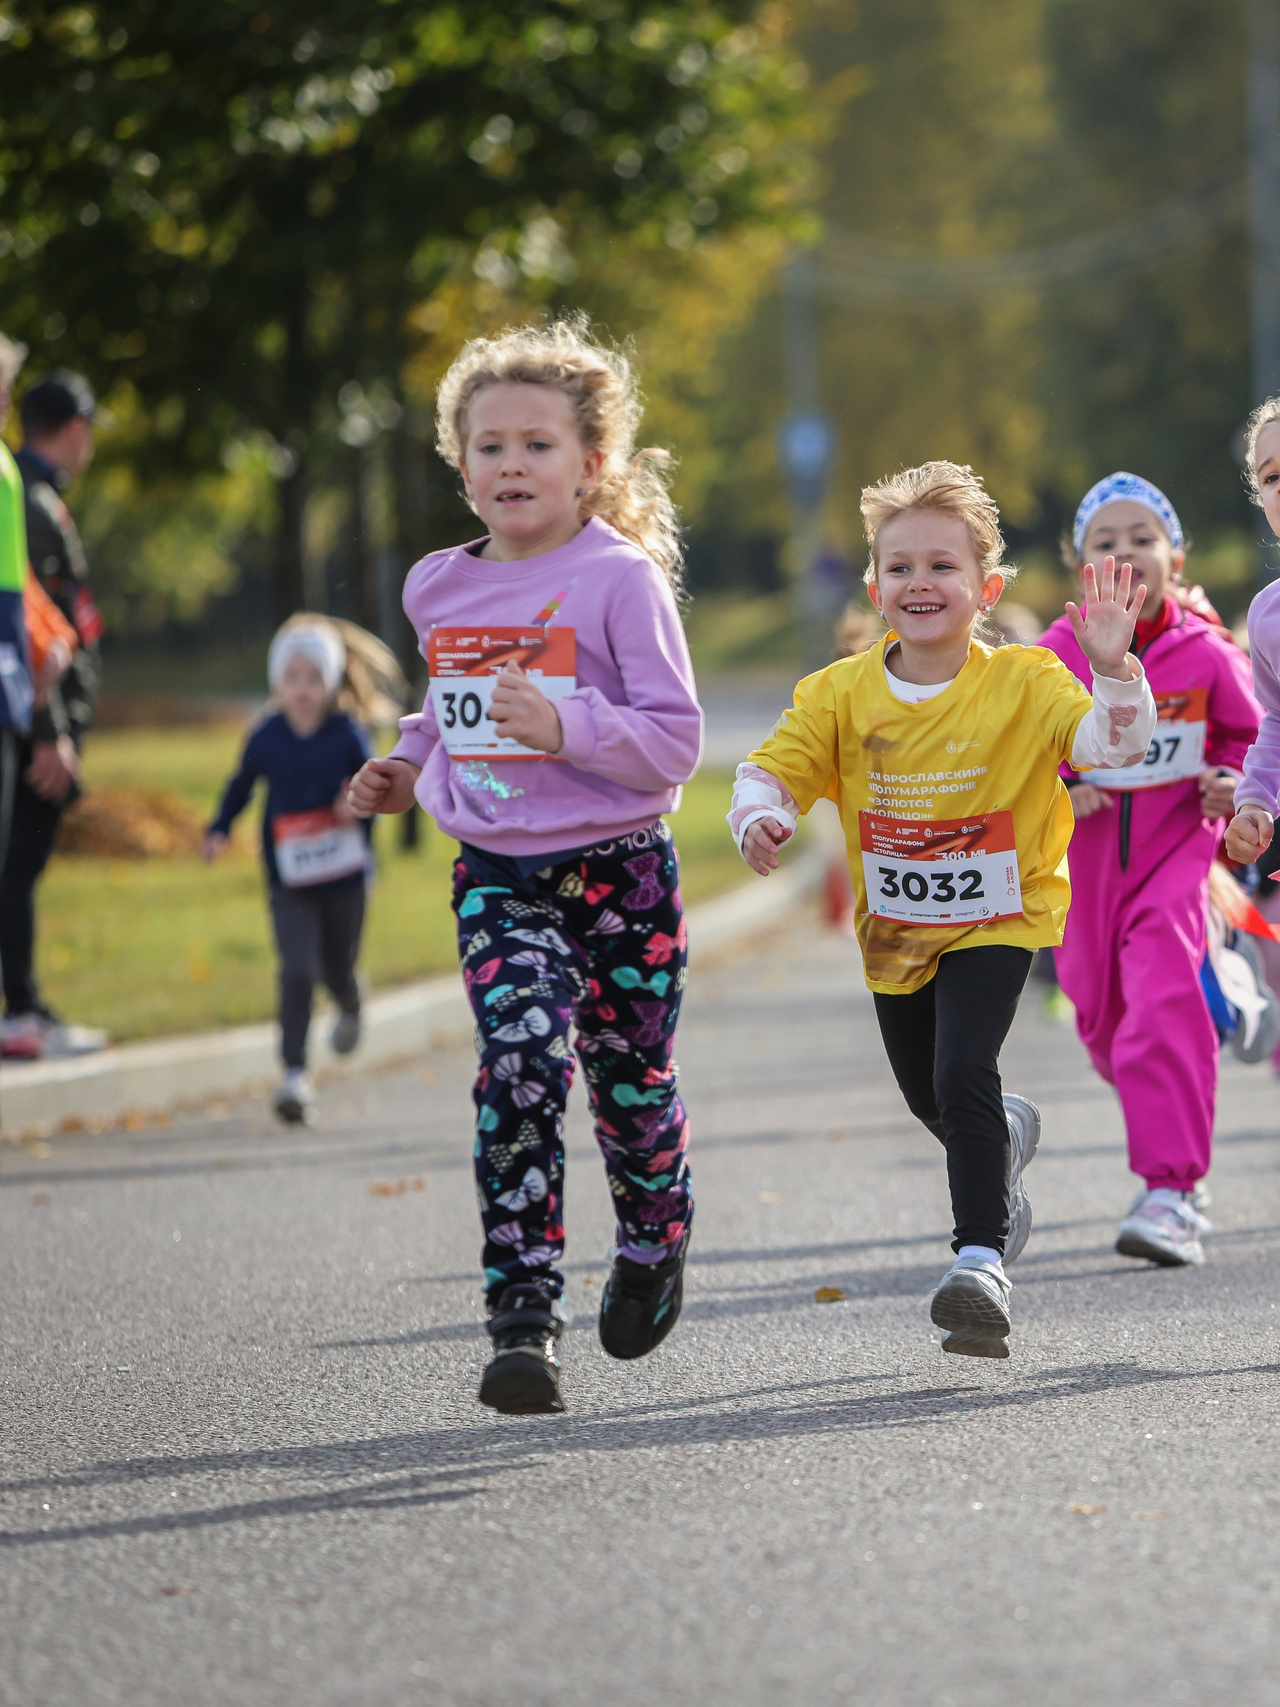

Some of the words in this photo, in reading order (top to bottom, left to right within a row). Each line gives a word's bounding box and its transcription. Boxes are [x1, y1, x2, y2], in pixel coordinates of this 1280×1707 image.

[442, 692, 494, 728] 30
[883, 766, 981, 783] ЯРОСЛАВСКИЙ
[873, 782, 970, 796] ПОЛУМАРАФОН
[874, 835, 922, 847] ПОЛУМАРАФОН
[878, 866, 985, 903] 3032
